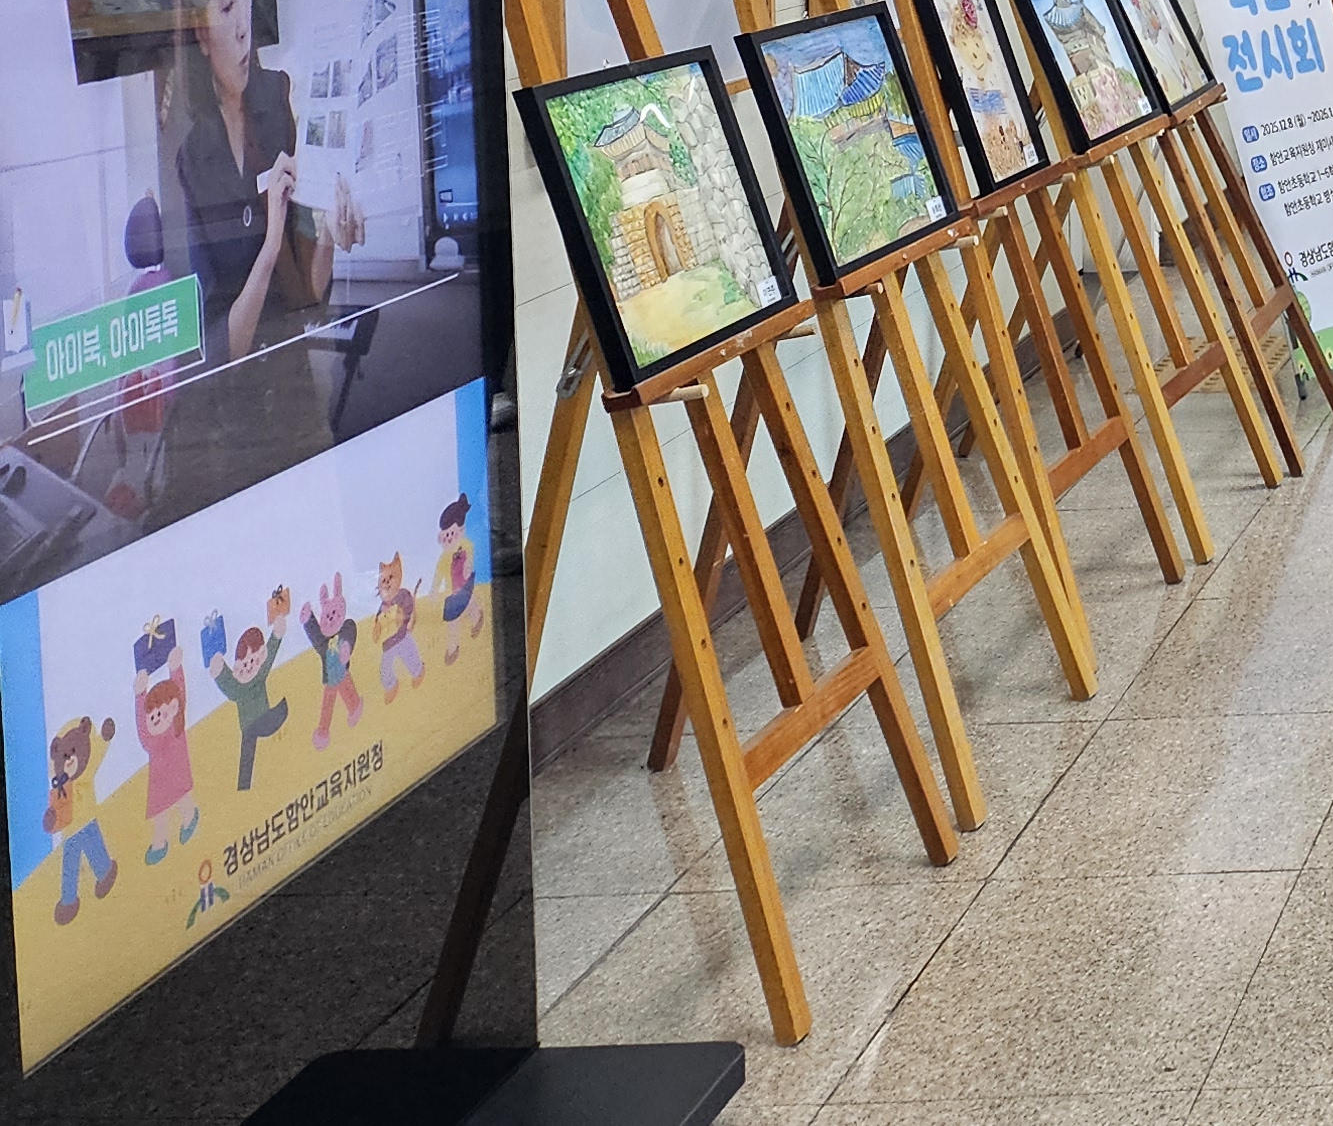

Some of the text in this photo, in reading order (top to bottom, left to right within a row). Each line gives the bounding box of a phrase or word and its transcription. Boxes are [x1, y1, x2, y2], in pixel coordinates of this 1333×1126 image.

[1223, 17, 1326, 93] 전시회
[1270, 141, 1316, 166] 함안교육지원청
[1278, 170, 1317, 194] 함안초등학교
[1284, 194, 1322, 216] 함안초등학교
[46, 299, 178, 382] 아이북, 아이톡톡
[224, 740, 383, 877] 경상남도함안교육지원청
